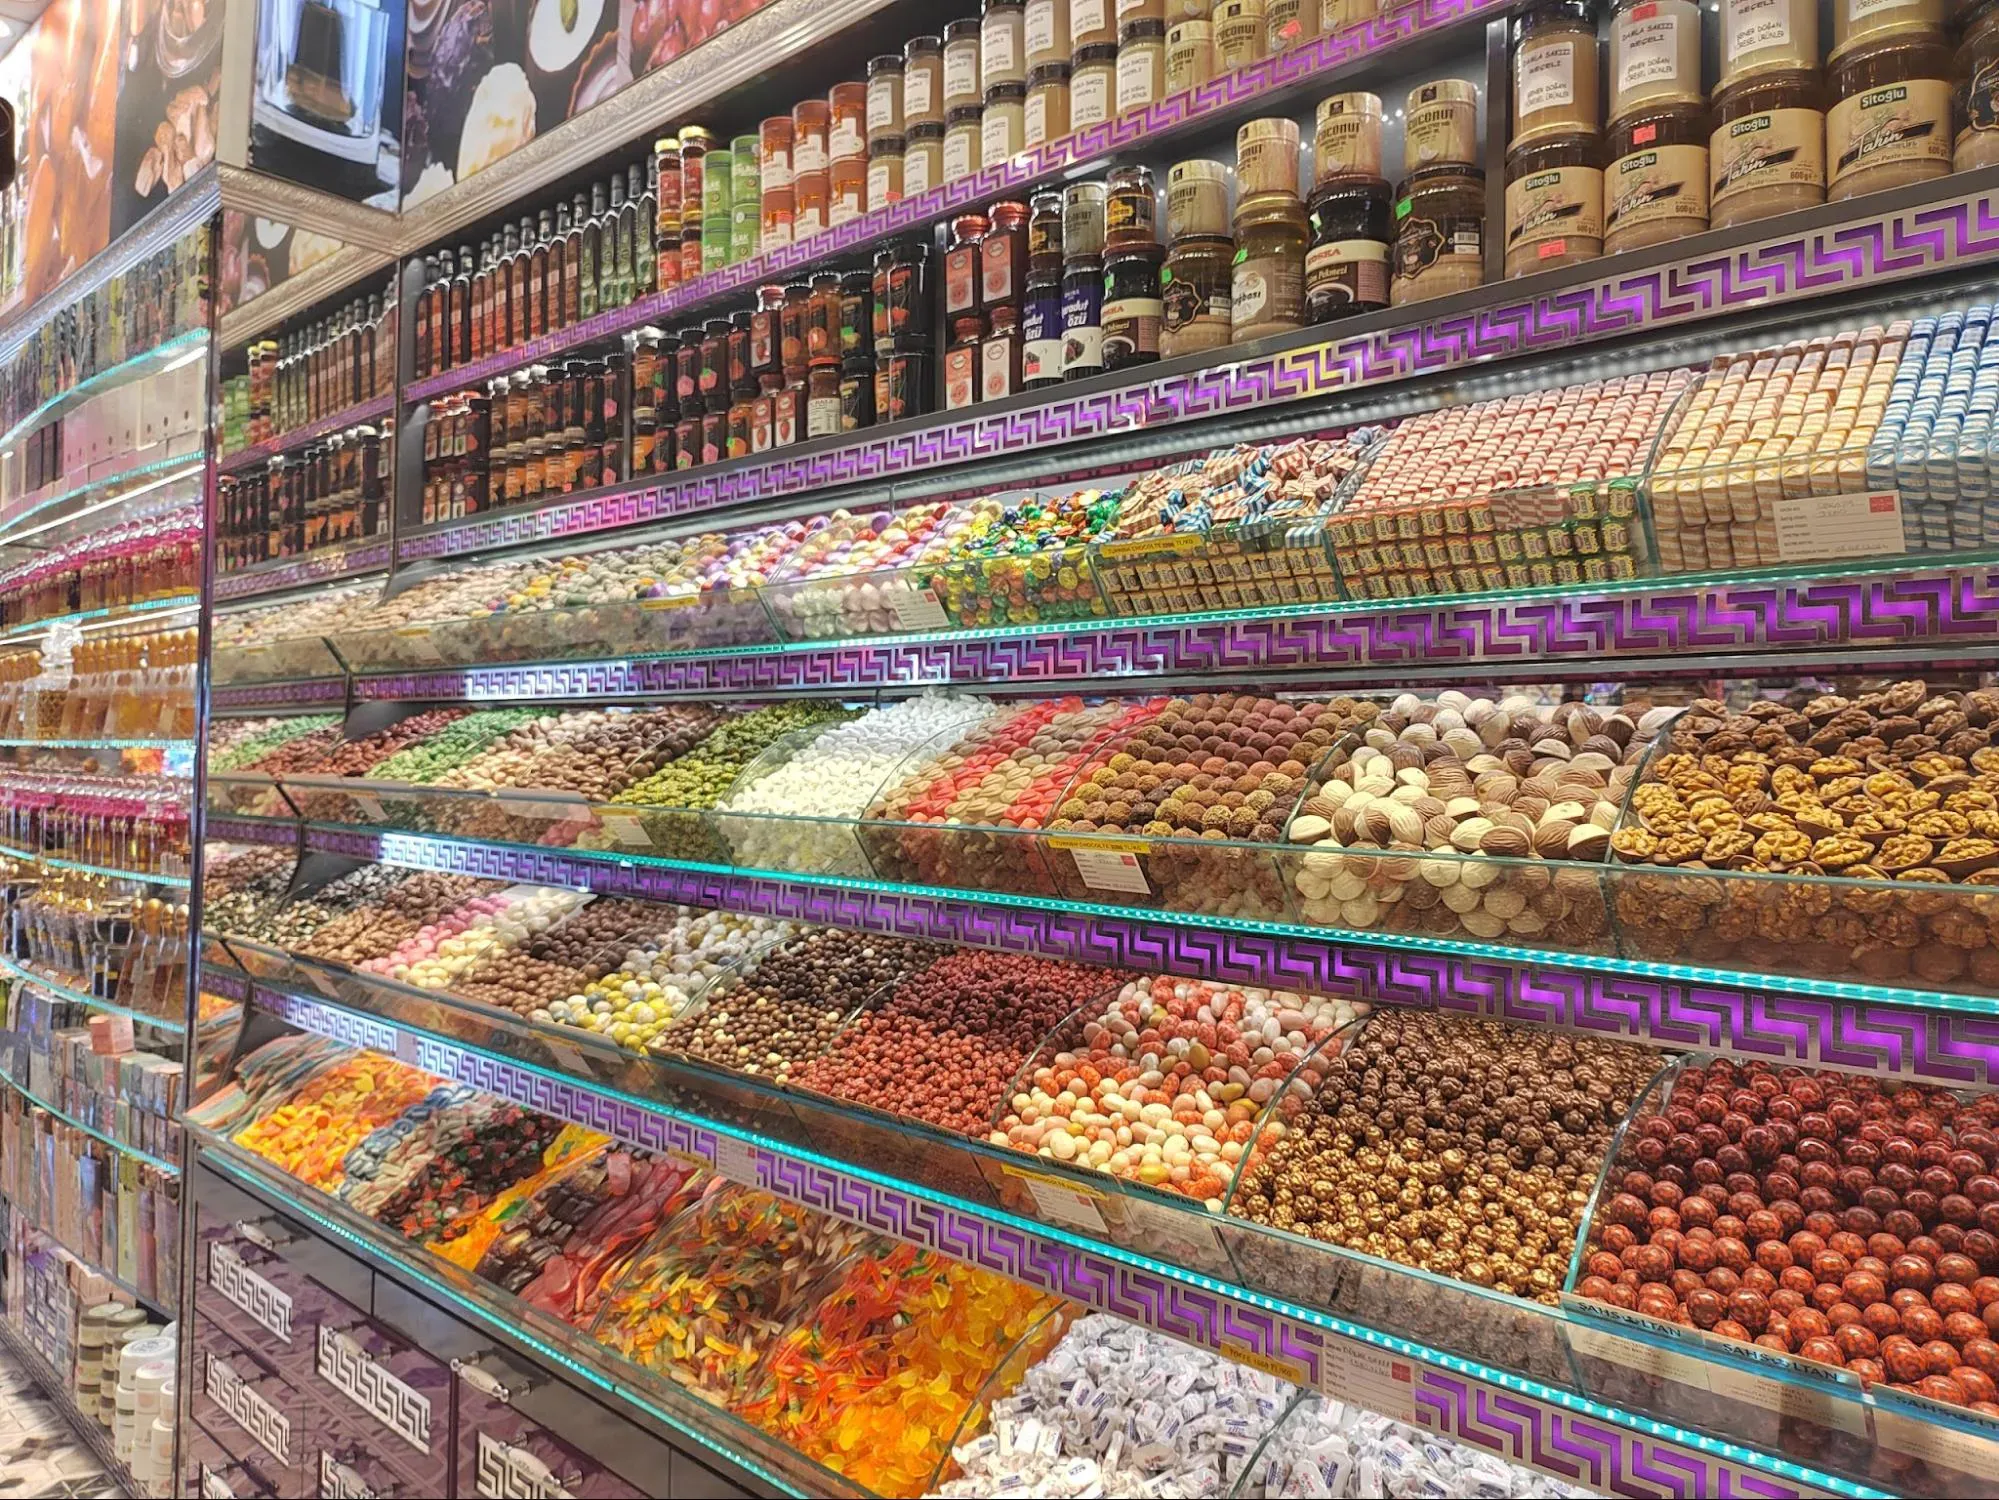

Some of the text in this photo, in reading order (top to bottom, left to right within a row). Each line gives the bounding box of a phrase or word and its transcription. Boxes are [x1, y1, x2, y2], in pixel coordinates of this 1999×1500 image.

[1850, 124, 1904, 160] Tahin
[1720, 147, 1767, 186] Tahin
[1515, 204, 1557, 236] Tahin
[1613, 188, 1654, 220] Tahin
